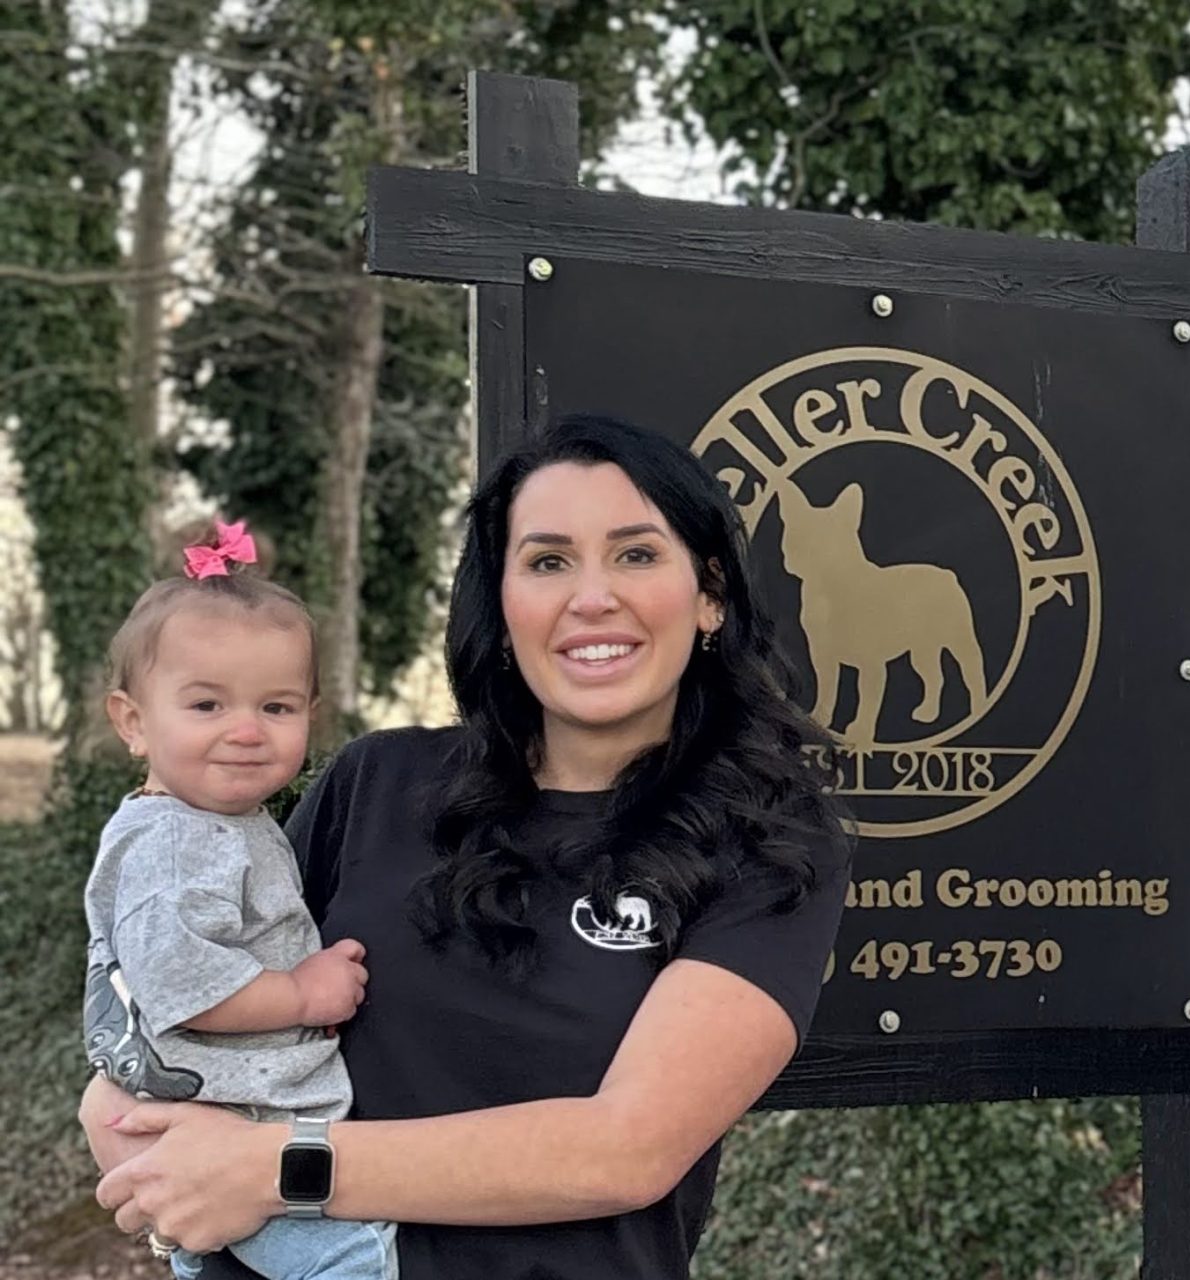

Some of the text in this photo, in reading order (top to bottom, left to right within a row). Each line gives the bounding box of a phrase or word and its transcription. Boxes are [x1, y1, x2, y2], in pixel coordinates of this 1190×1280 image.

[704, 366, 1092, 616] eller Creek
[892, 749, 996, 792] 2018
[935, 868, 1170, 917] Grooming
[850, 939, 1063, 981] 491-3730
